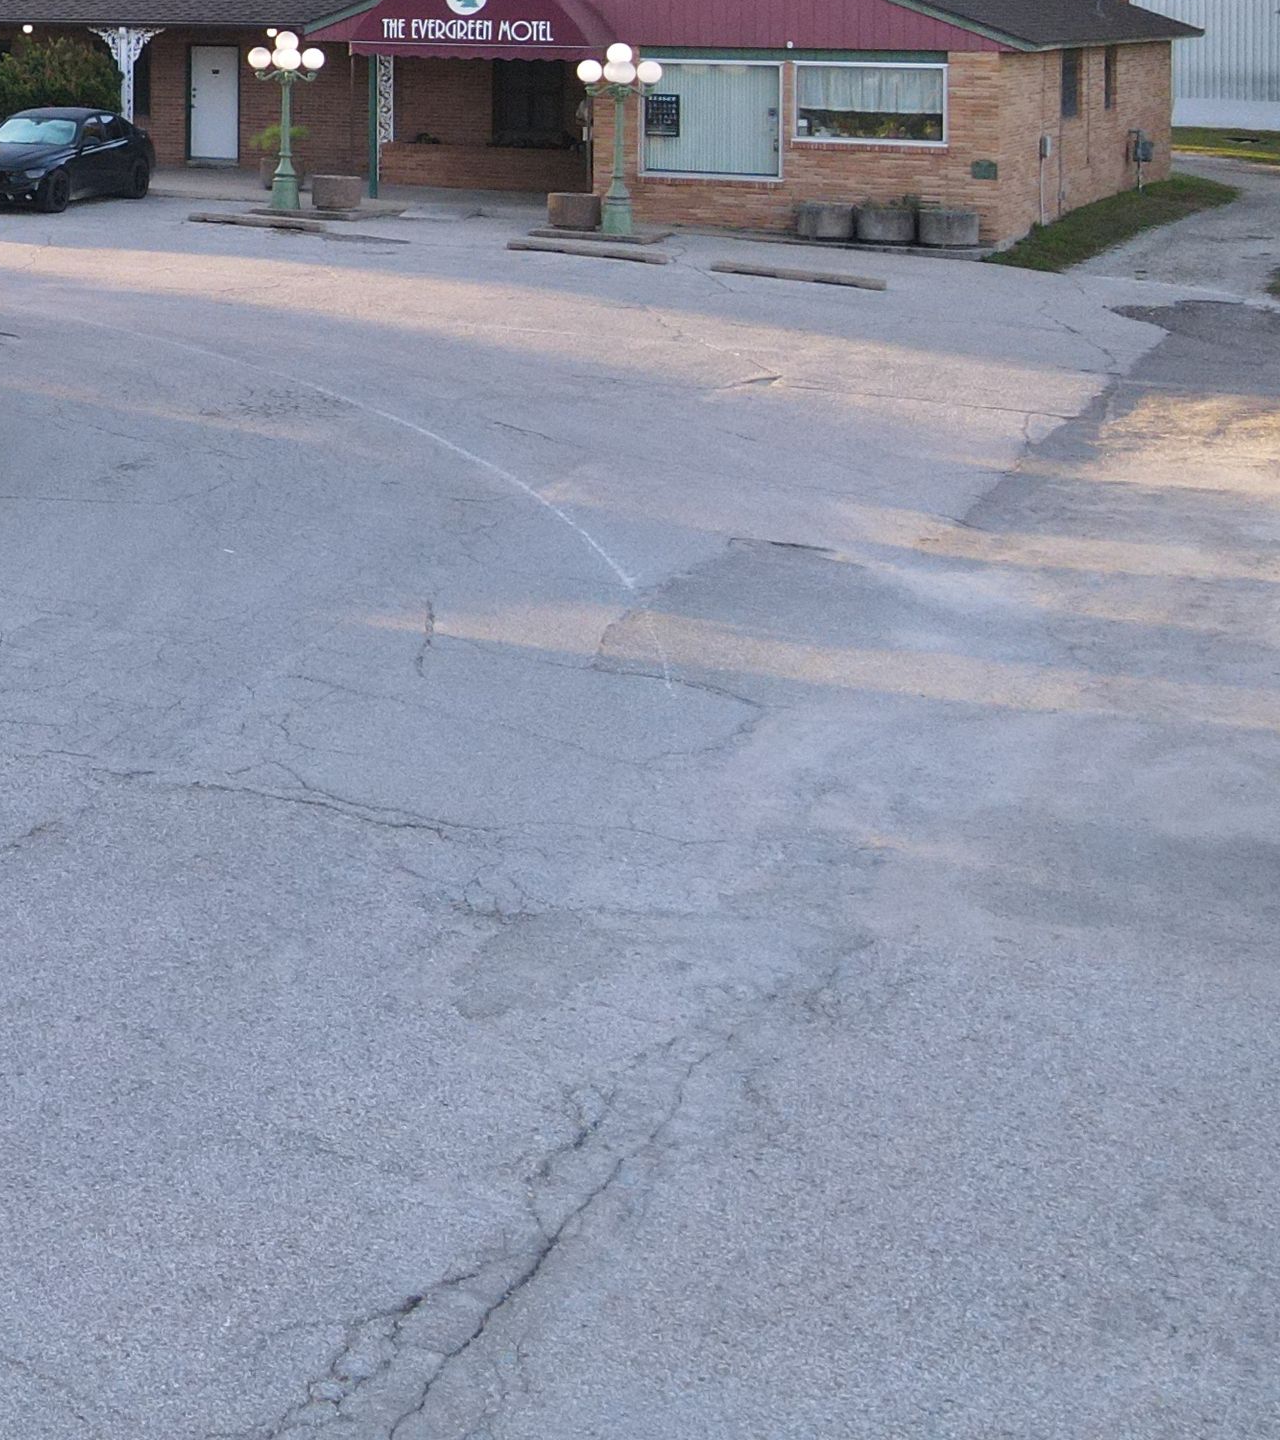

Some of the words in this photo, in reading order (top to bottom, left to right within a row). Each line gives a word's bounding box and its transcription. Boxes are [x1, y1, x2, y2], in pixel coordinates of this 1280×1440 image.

[381, 18, 406, 39] THE
[411, 19, 492, 41] EVERGREEN
[498, 20, 554, 42] MOTEL
